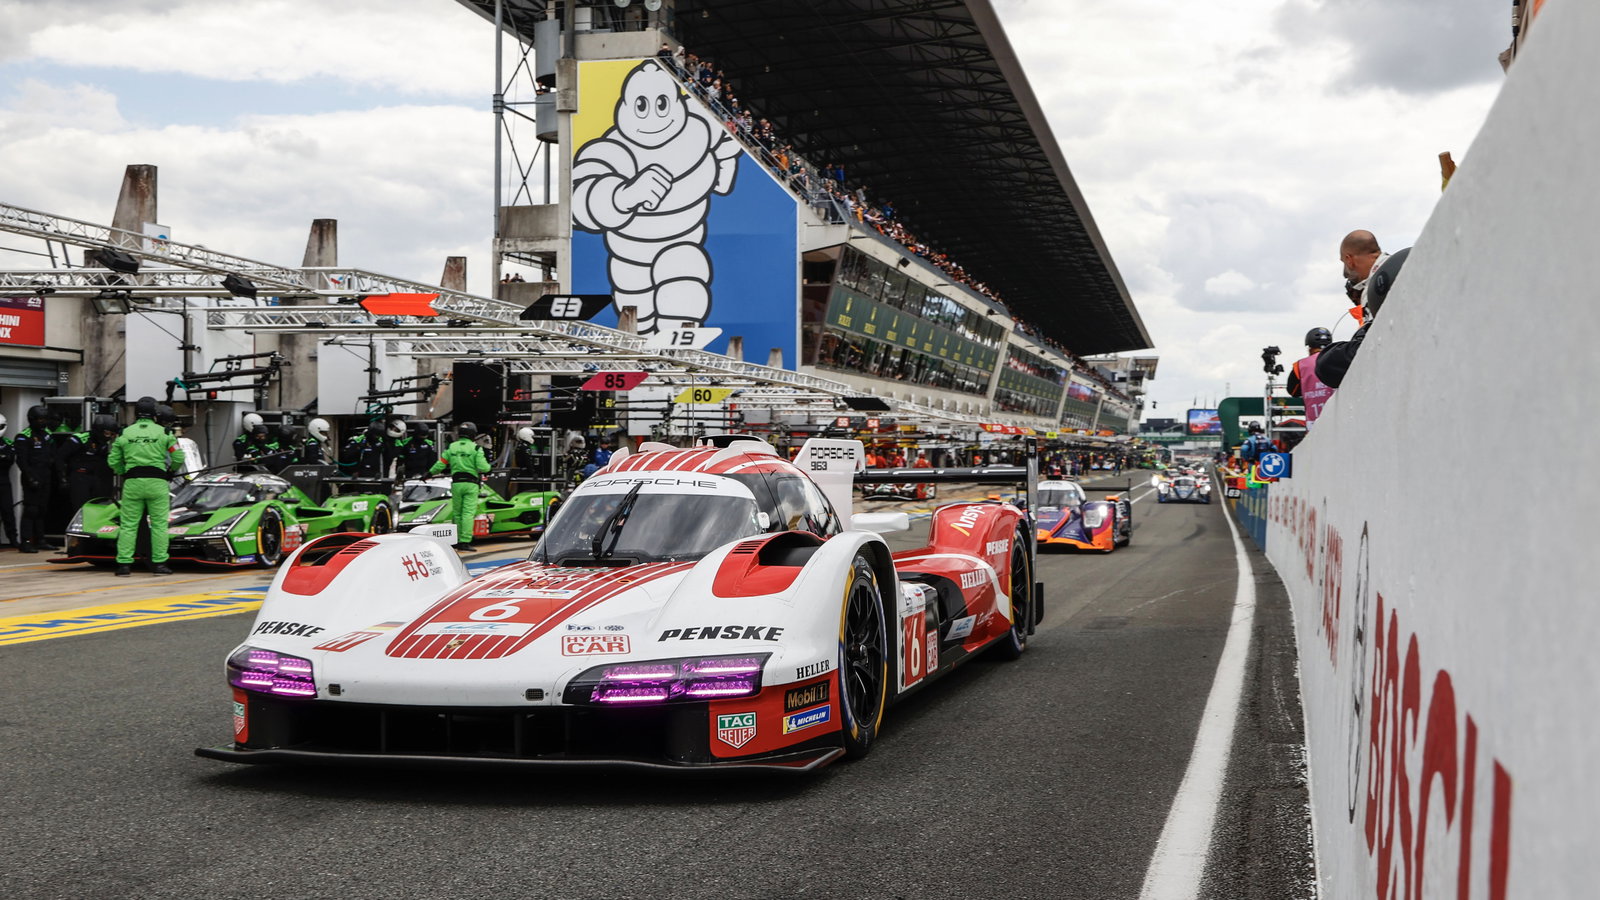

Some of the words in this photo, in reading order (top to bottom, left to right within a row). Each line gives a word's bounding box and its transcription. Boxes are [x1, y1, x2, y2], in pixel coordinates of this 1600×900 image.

[550, 297, 583, 317] 63
[671, 331, 695, 345] 19
[604, 374, 624, 388] 85
[694, 389, 711, 401] 60
[811, 447, 854, 459] PORSCHE
[811, 461, 827, 470] 963
[582, 478, 717, 489] PORSCHE
[1228, 489, 1240, 497] 63
[950, 505, 987, 537] Ansys
[432, 529, 452, 538] HELLER
[986, 539, 1009, 556] PENSKE
[401, 553, 430, 582] #6
[0, 597, 265, 636] HELIN
[468, 598, 527, 621] 6
[253, 621, 325, 637] PENSKE
[658, 625, 784, 642] PENSKE
[567, 634, 624, 643] HYPER
[567, 642, 624, 654] CAR
[910, 617, 921, 678] 6
[796, 659, 830, 680] HELLER
[787, 689, 816, 709] Mobil
[721, 715, 754, 727] TAG
[797, 711, 827, 726] MICHELIN
[720, 728, 754, 746] HEUER
[1365, 591, 1513, 900] BOSC
